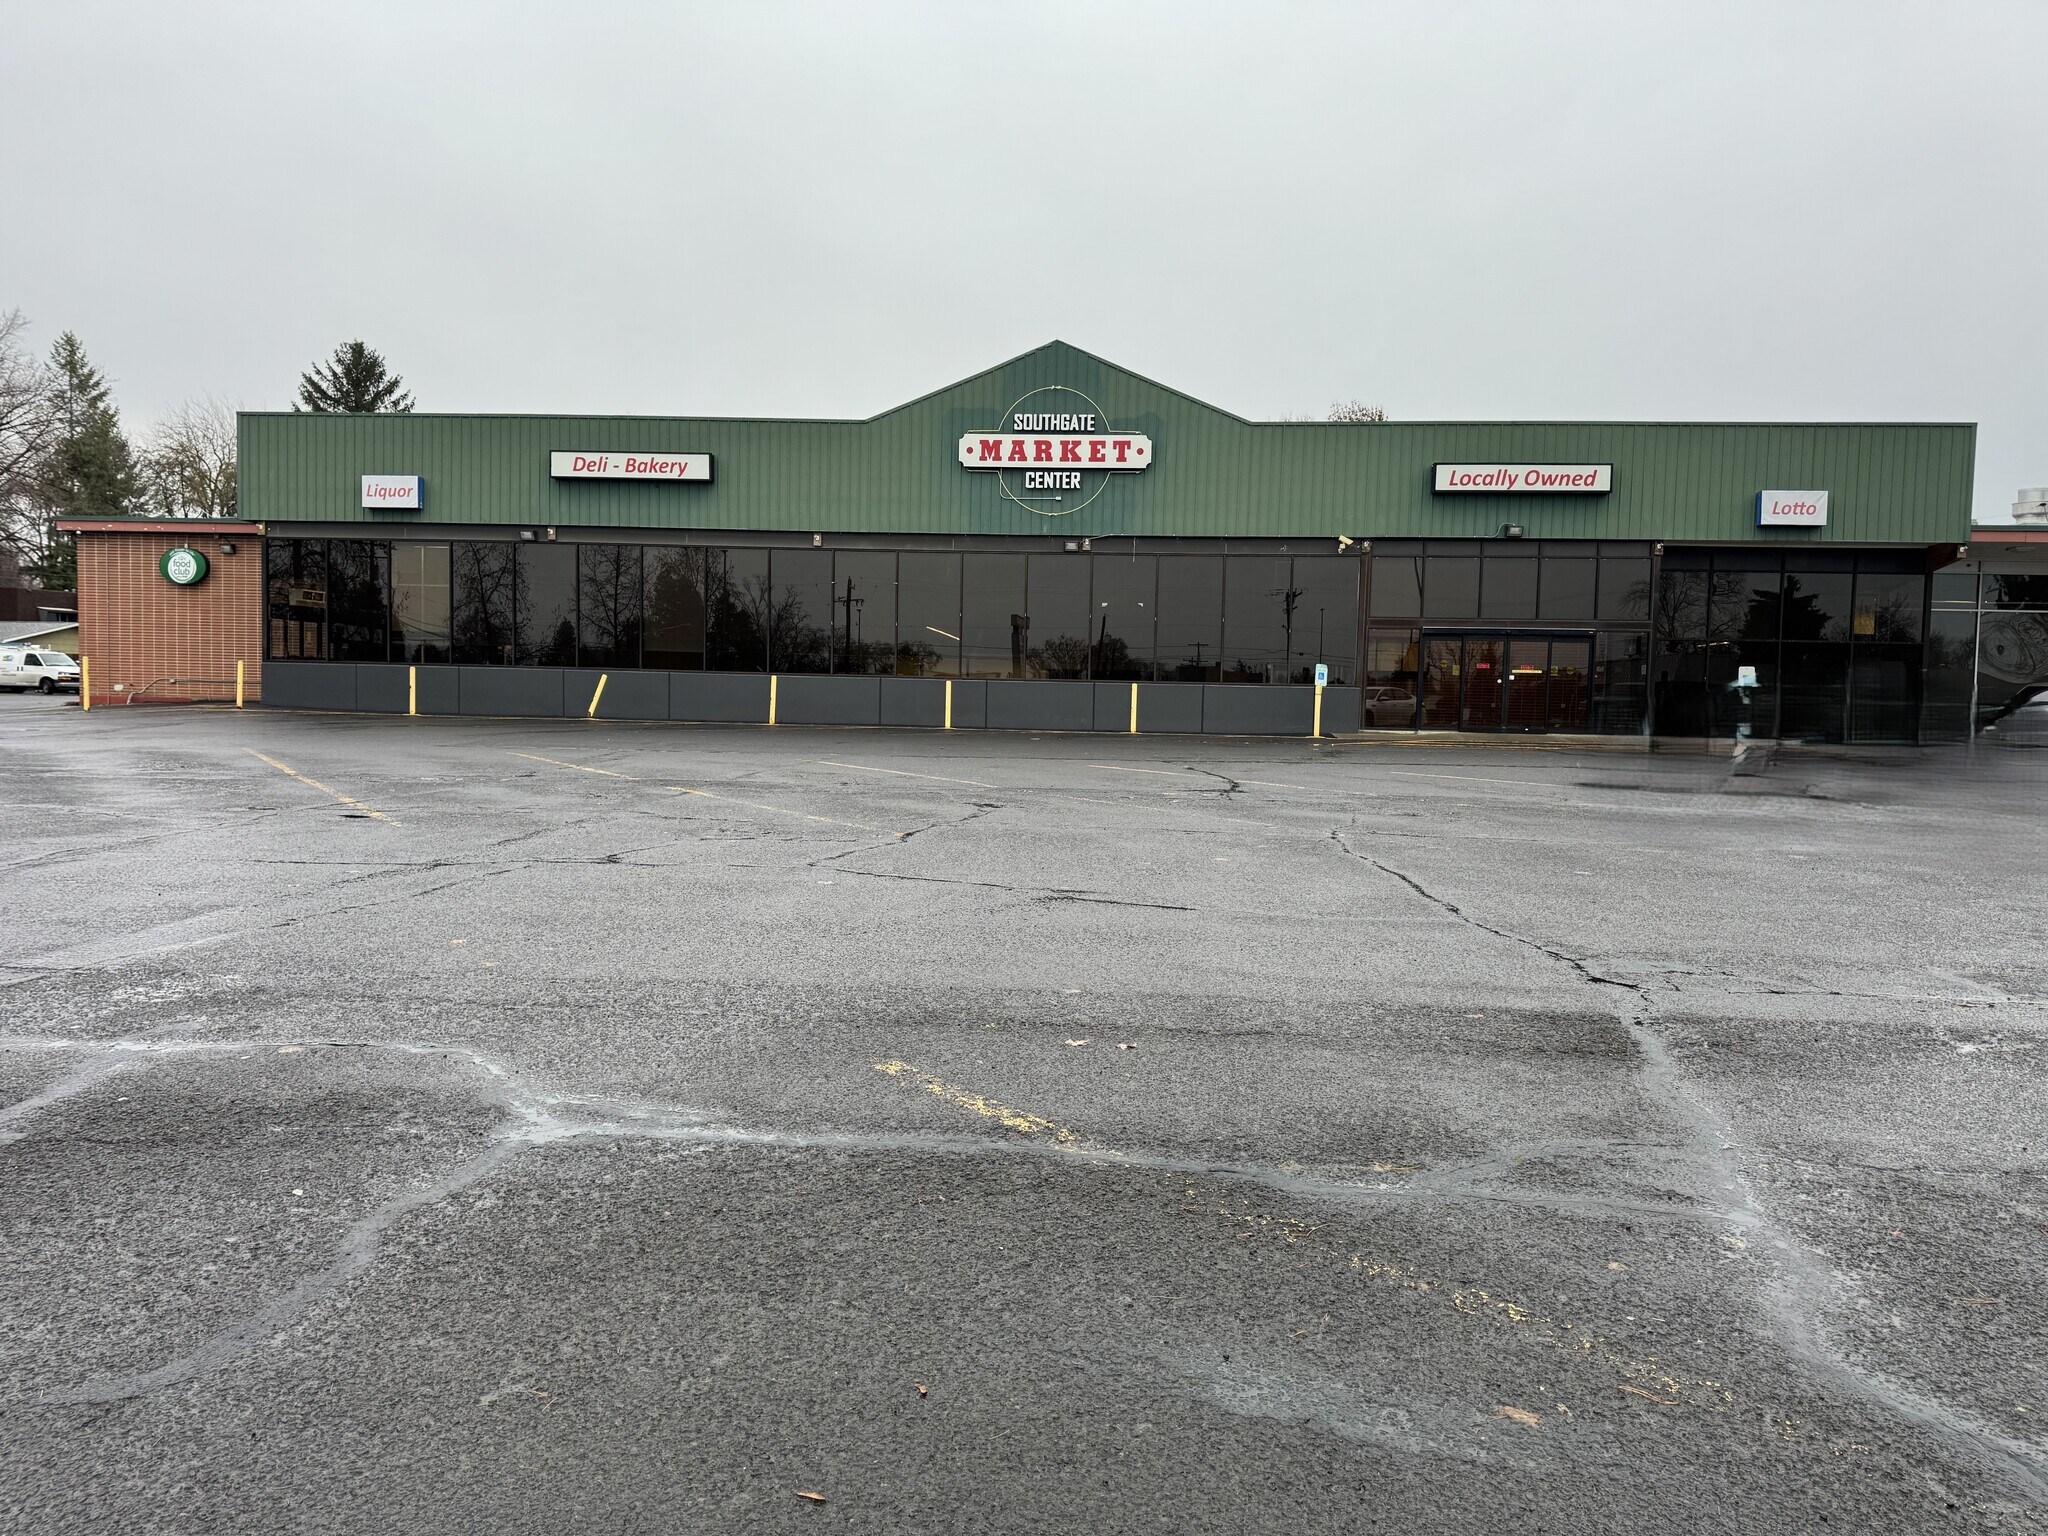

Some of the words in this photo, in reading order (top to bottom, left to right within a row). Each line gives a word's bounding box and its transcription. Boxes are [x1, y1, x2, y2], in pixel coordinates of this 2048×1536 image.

[1013, 413, 1096, 431] SOUTHGATE
[979, 440, 1132, 463] MARKET
[572, 456, 609, 474] Deli
[624, 457, 688, 477] Bakery
[1025, 471, 1081, 490] CENTER
[1448, 468, 1519, 491] Locally
[1524, 470, 1597, 487] Owned
[366, 483, 414, 500] Liquor
[1772, 500, 1818, 516] Lotto
[173, 558, 191, 568] food
[173, 568, 191, 576] club
